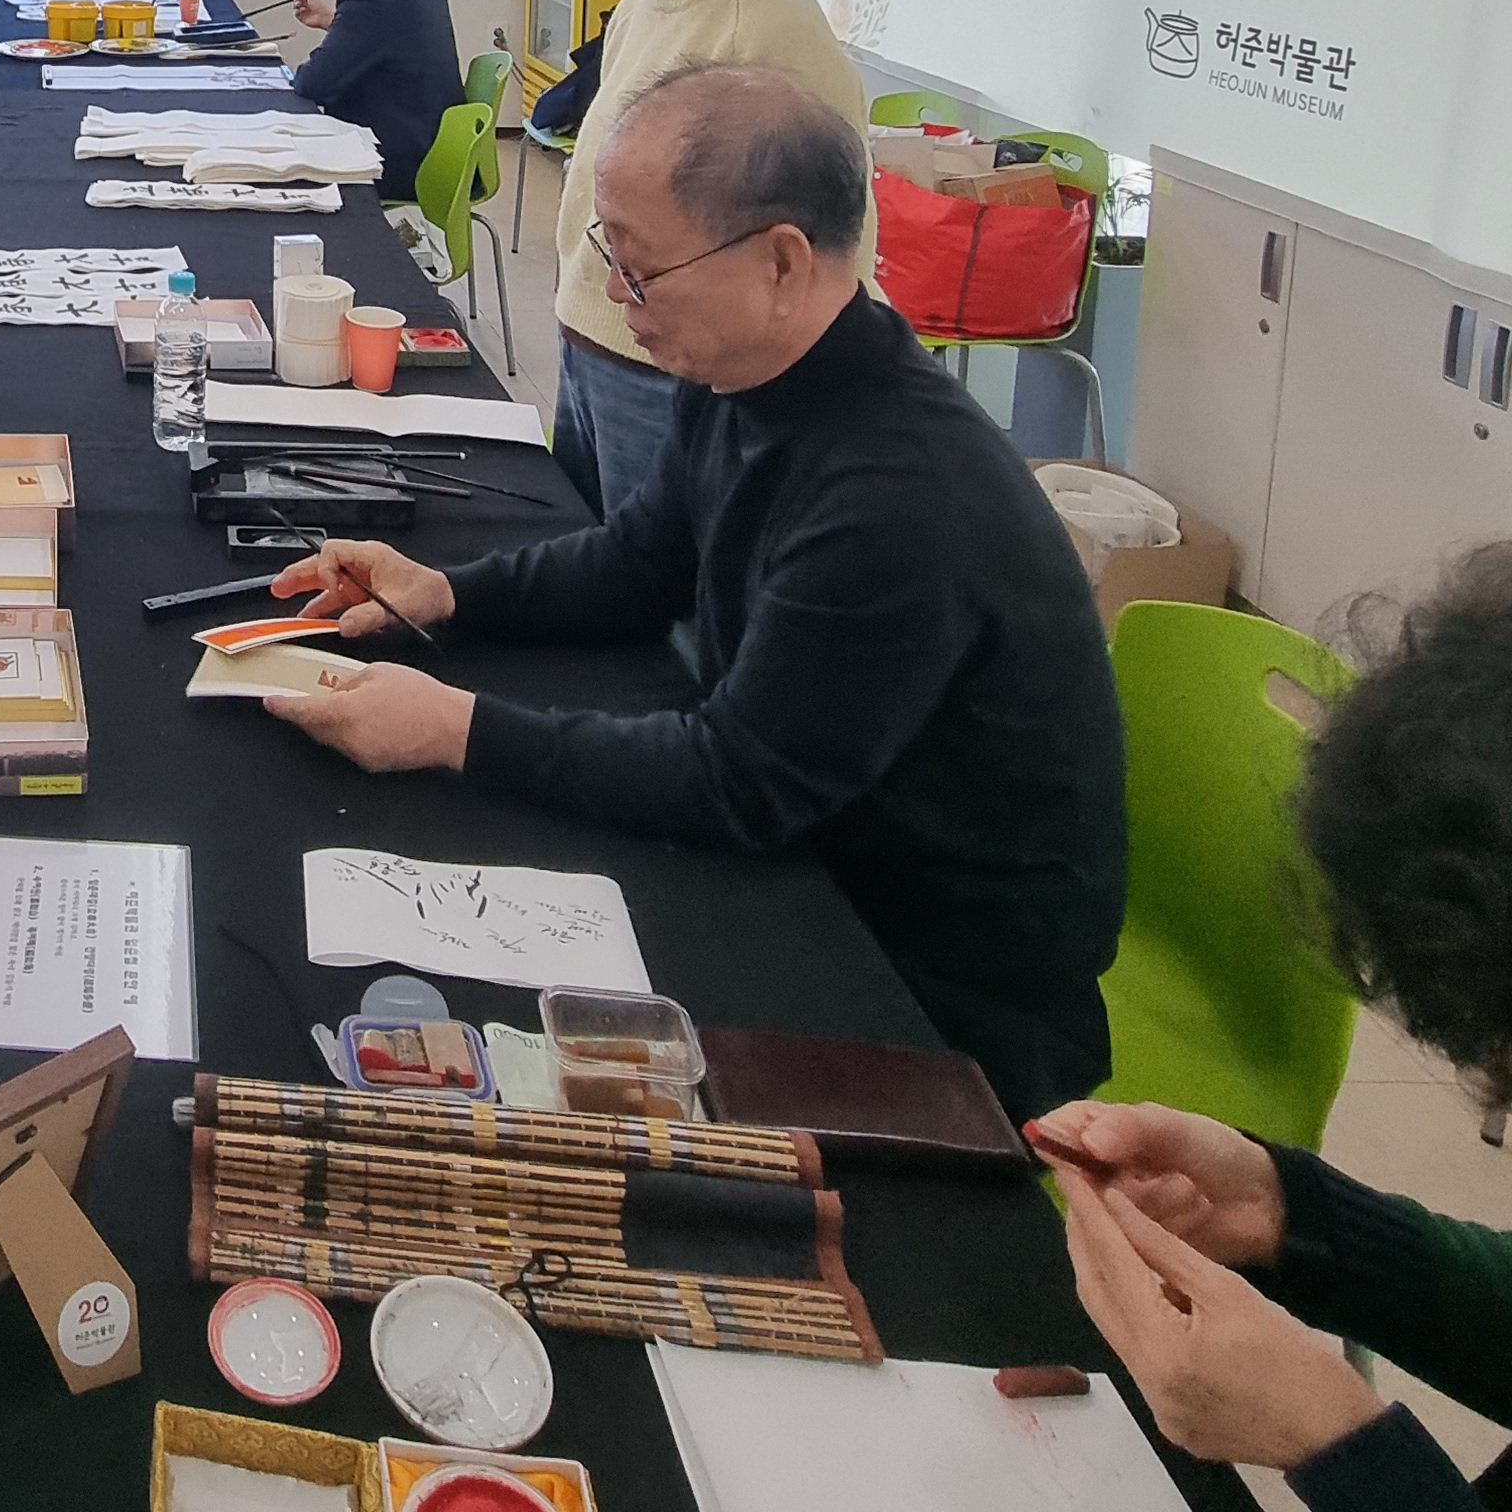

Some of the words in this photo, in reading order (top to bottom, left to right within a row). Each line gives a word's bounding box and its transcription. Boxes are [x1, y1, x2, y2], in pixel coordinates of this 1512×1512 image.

[1215, 22, 1357, 92] 허준박물관
[1208, 69, 1268, 100] HEOJUN
[1271, 85, 1345, 121] MUSEUM
[78, 1295, 109, 1324] 20
